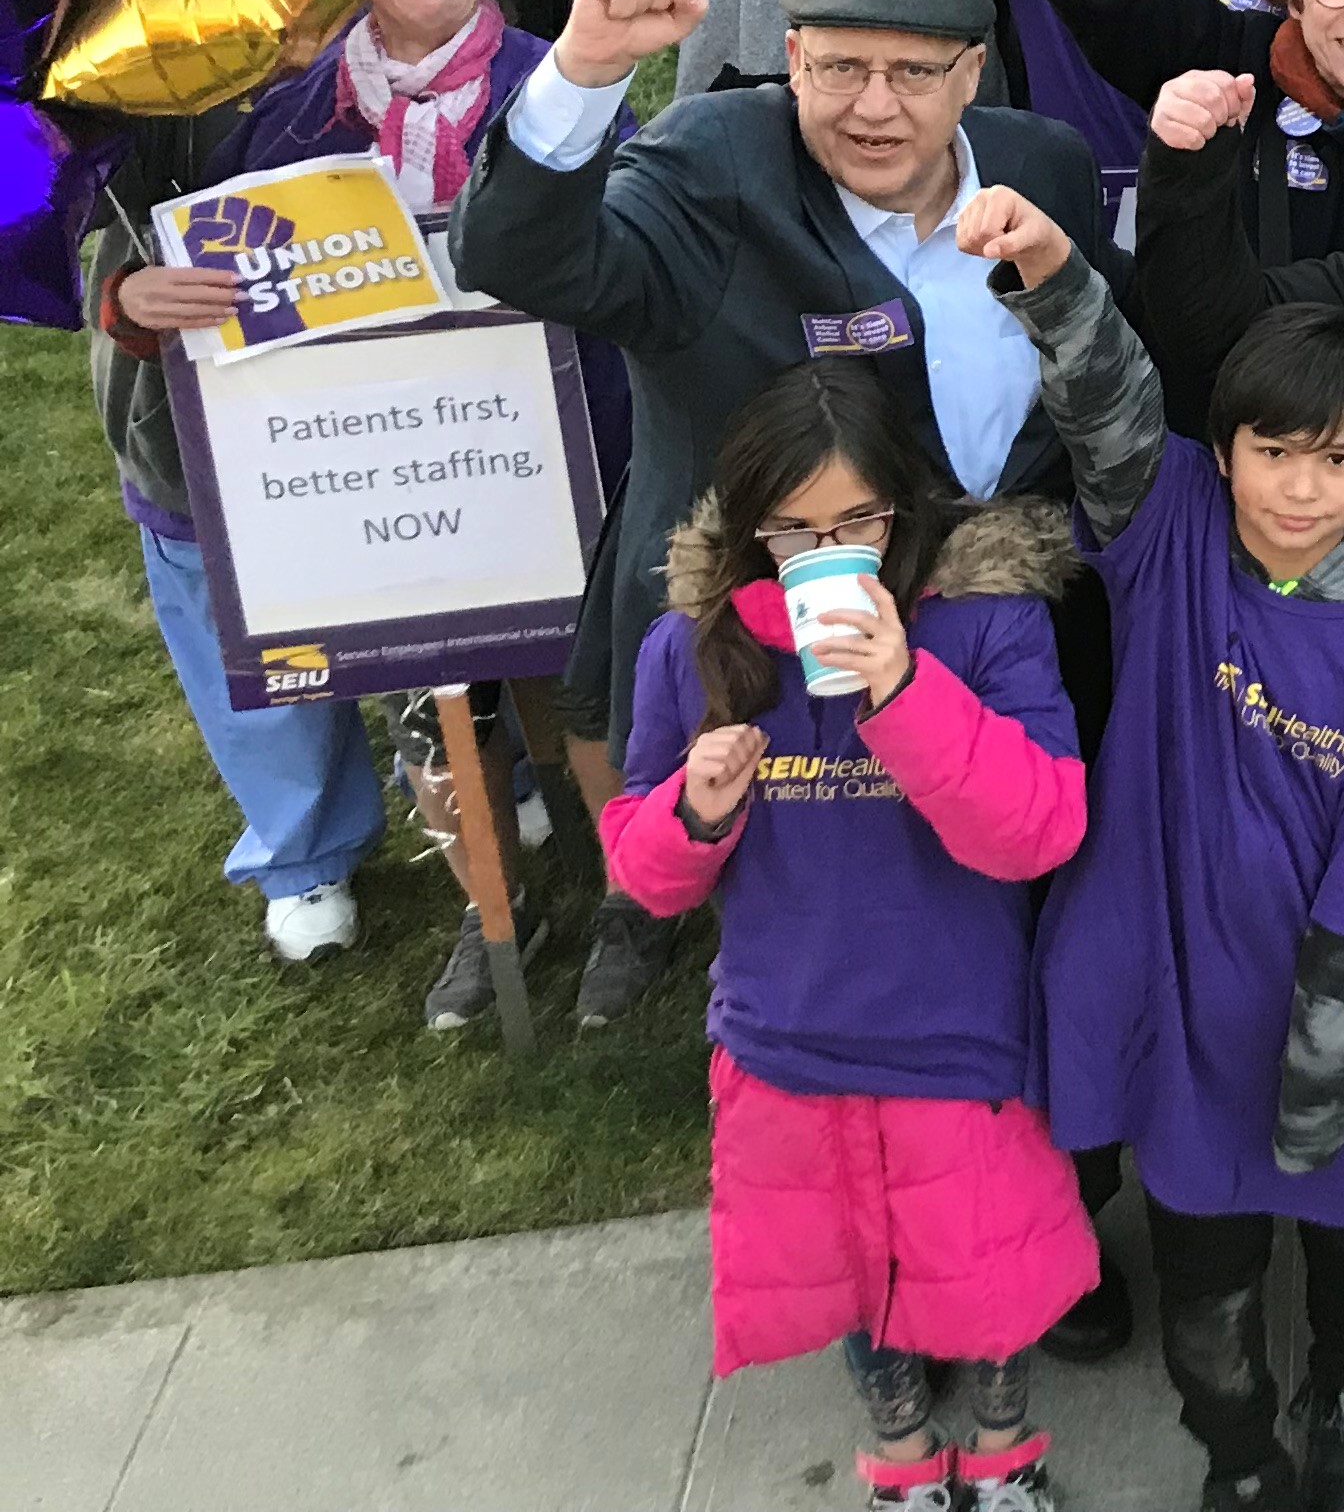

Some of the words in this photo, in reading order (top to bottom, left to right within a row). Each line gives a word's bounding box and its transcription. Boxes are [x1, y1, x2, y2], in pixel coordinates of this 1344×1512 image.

[233, 226, 384, 281] UNION
[249, 255, 421, 314] STRONG
[266, 406, 424, 444] Patients
[433, 392, 521, 425] first,
[261, 465, 380, 501] better
[393, 448, 544, 487] staffing,
[363, 508, 463, 546] NOW
[265, 669, 331, 694] SEIU
[815, 780, 839, 801] for
